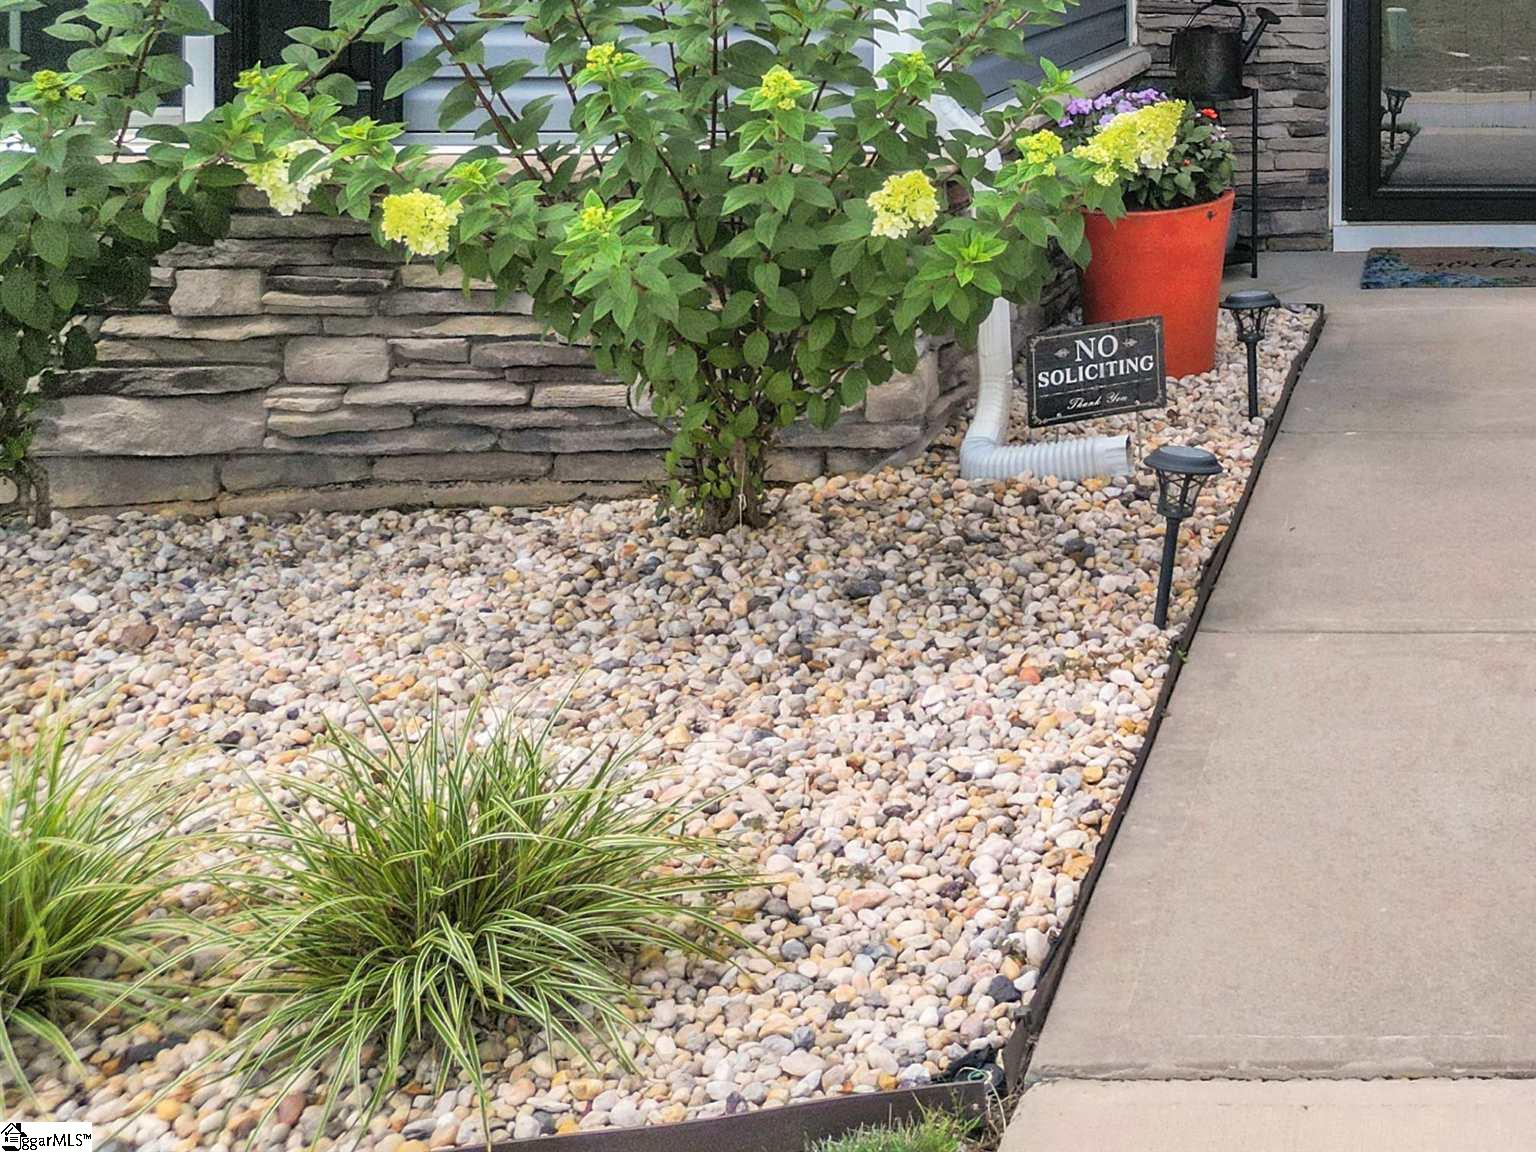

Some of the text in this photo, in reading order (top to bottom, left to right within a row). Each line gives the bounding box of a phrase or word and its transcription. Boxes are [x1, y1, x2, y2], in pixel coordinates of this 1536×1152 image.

[1074, 334, 1119, 362] NO
[1037, 355, 1155, 388] SOLICITING
[1066, 391, 1128, 410] Thank You
